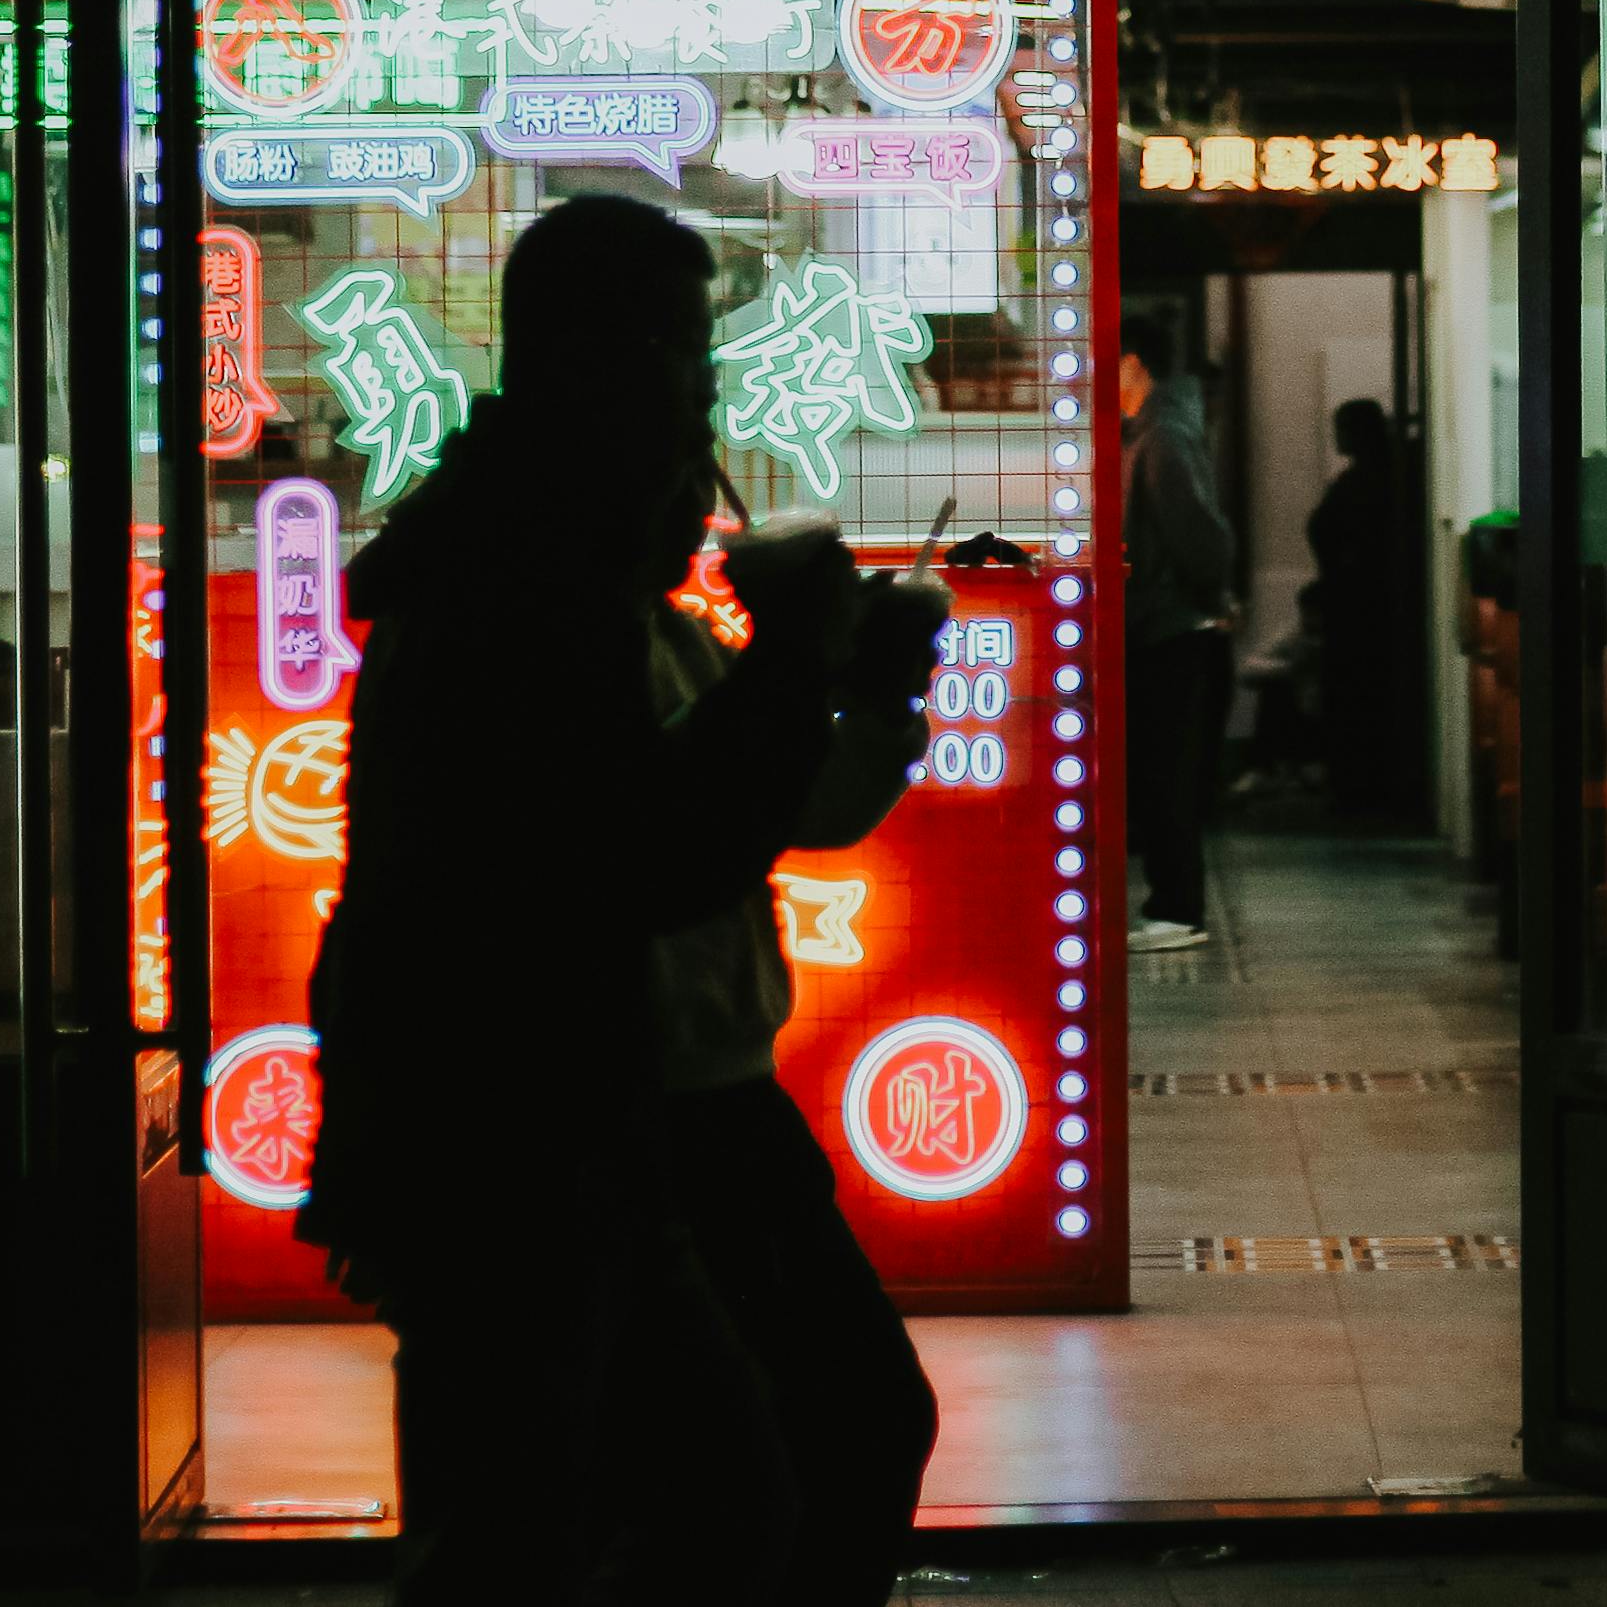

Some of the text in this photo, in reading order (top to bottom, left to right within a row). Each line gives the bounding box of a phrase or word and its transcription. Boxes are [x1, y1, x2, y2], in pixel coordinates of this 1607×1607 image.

[513, 94, 680, 136] 特色烧腊
[224, 142, 437, 182] 肠粉 豉油鸡
[814, 135, 973, 180] 四宝饭
